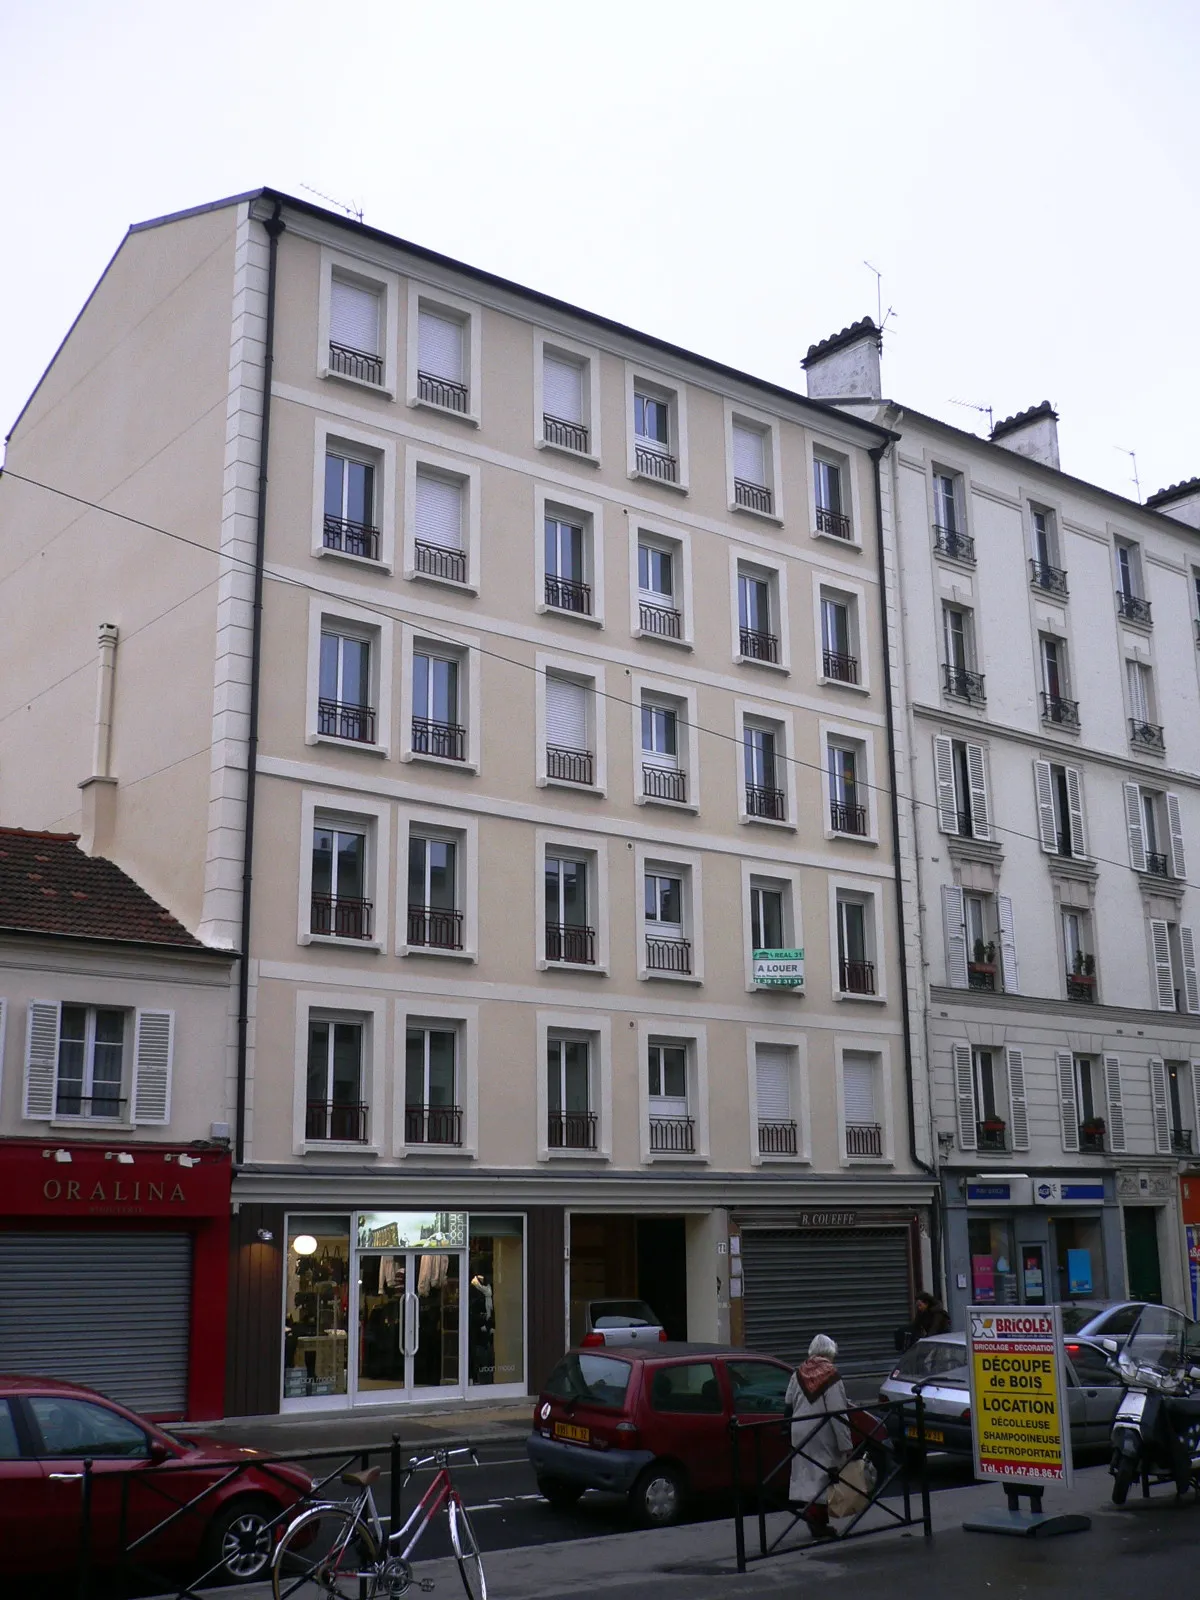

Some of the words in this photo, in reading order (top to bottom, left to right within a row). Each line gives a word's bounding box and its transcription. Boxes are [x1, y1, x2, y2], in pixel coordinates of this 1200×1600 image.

[43, 1179, 185, 1201] ORALINA
[449, 1214, 460, 1246] mood
[457, 1214, 467, 1245] urban
[974, 1343, 1009, 1351] BRICOLAGE
[982, 1356, 1051, 1373] DÉCOUPE
[990, 1375, 1005, 1387] de
[1009, 1376, 1042, 1389] BOIS
[983, 1398, 1055, 1415] LOCATION
[991, 1416, 1050, 1430] DÉCOLLEUSE
[984, 1431, 1061, 1444] SHAMPOOINEUSE
